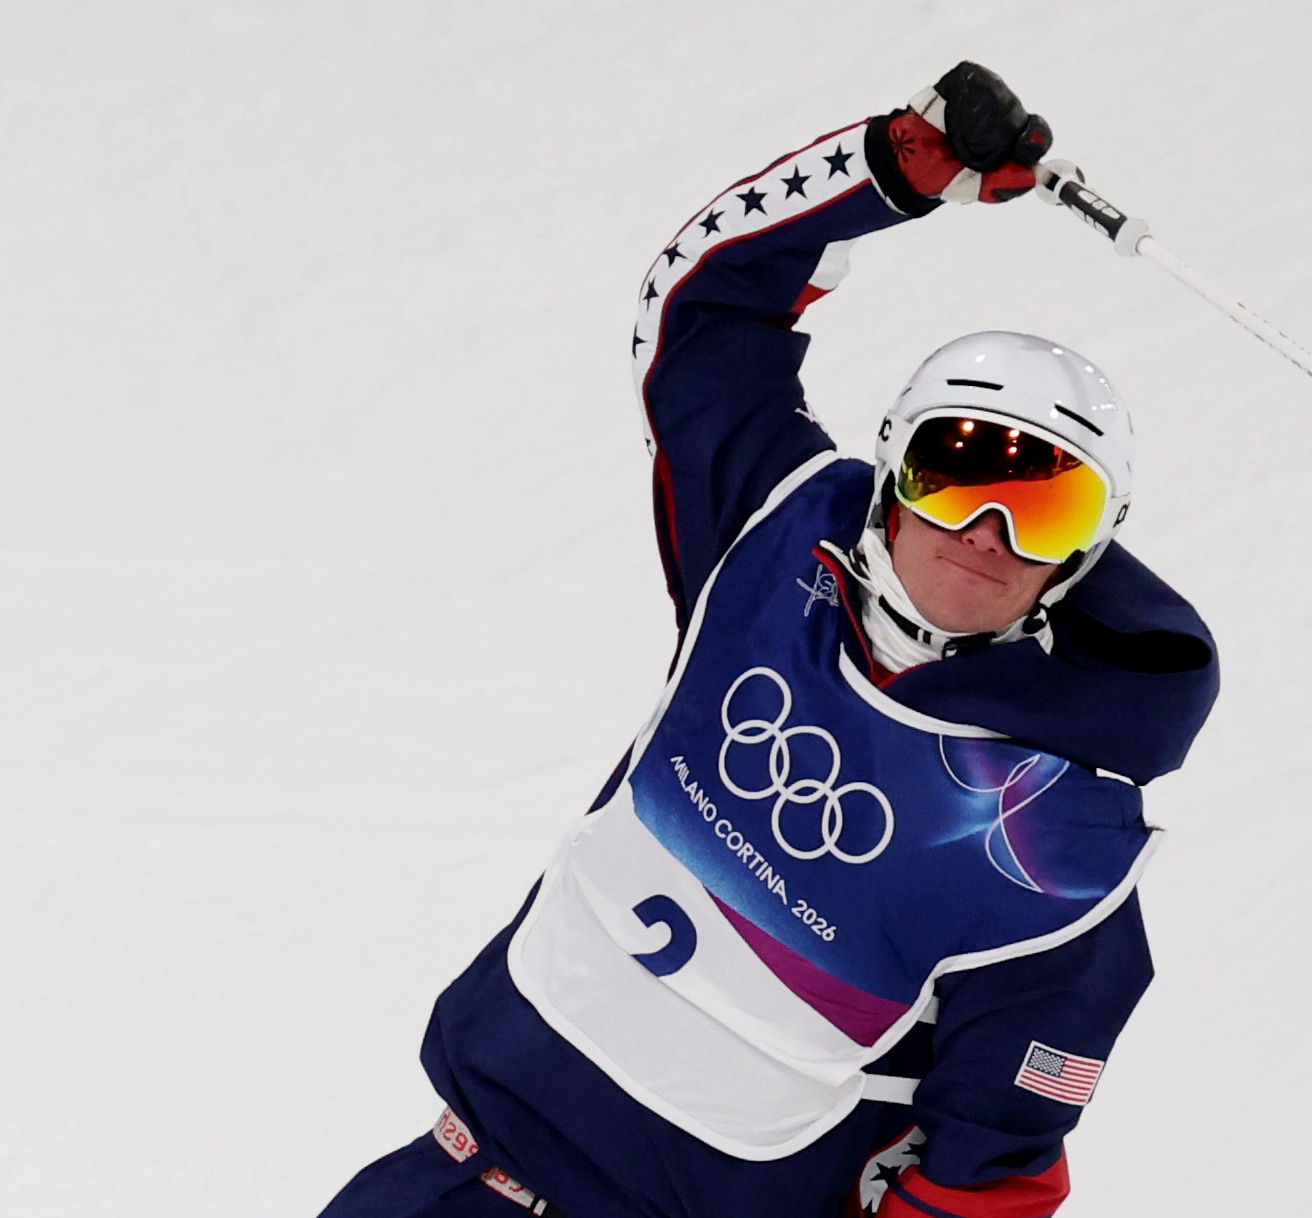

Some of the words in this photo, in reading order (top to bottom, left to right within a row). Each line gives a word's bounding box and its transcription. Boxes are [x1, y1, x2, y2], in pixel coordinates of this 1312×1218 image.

[670, 755, 718, 822] MILANO
[714, 819, 788, 905] CORTINA
[791, 899, 837, 942] 2026
[630, 894, 697, 977] 2
